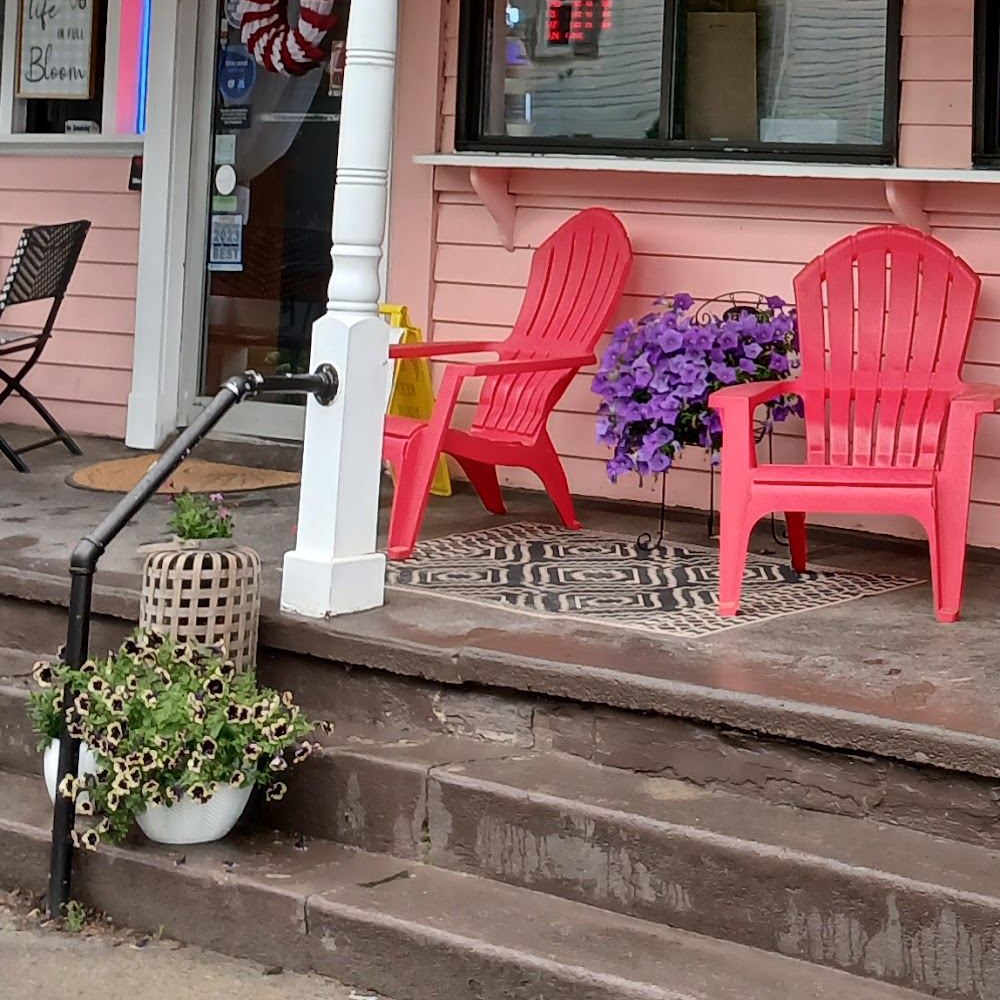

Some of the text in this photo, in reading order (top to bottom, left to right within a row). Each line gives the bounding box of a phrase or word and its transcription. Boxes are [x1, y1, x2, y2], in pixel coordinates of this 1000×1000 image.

[57, 28, 85, 41] IN FULL
[25, 43, 87, 83] Bloom
[213, 228, 240, 242] 2023
[213, 247, 239, 260] BEST
